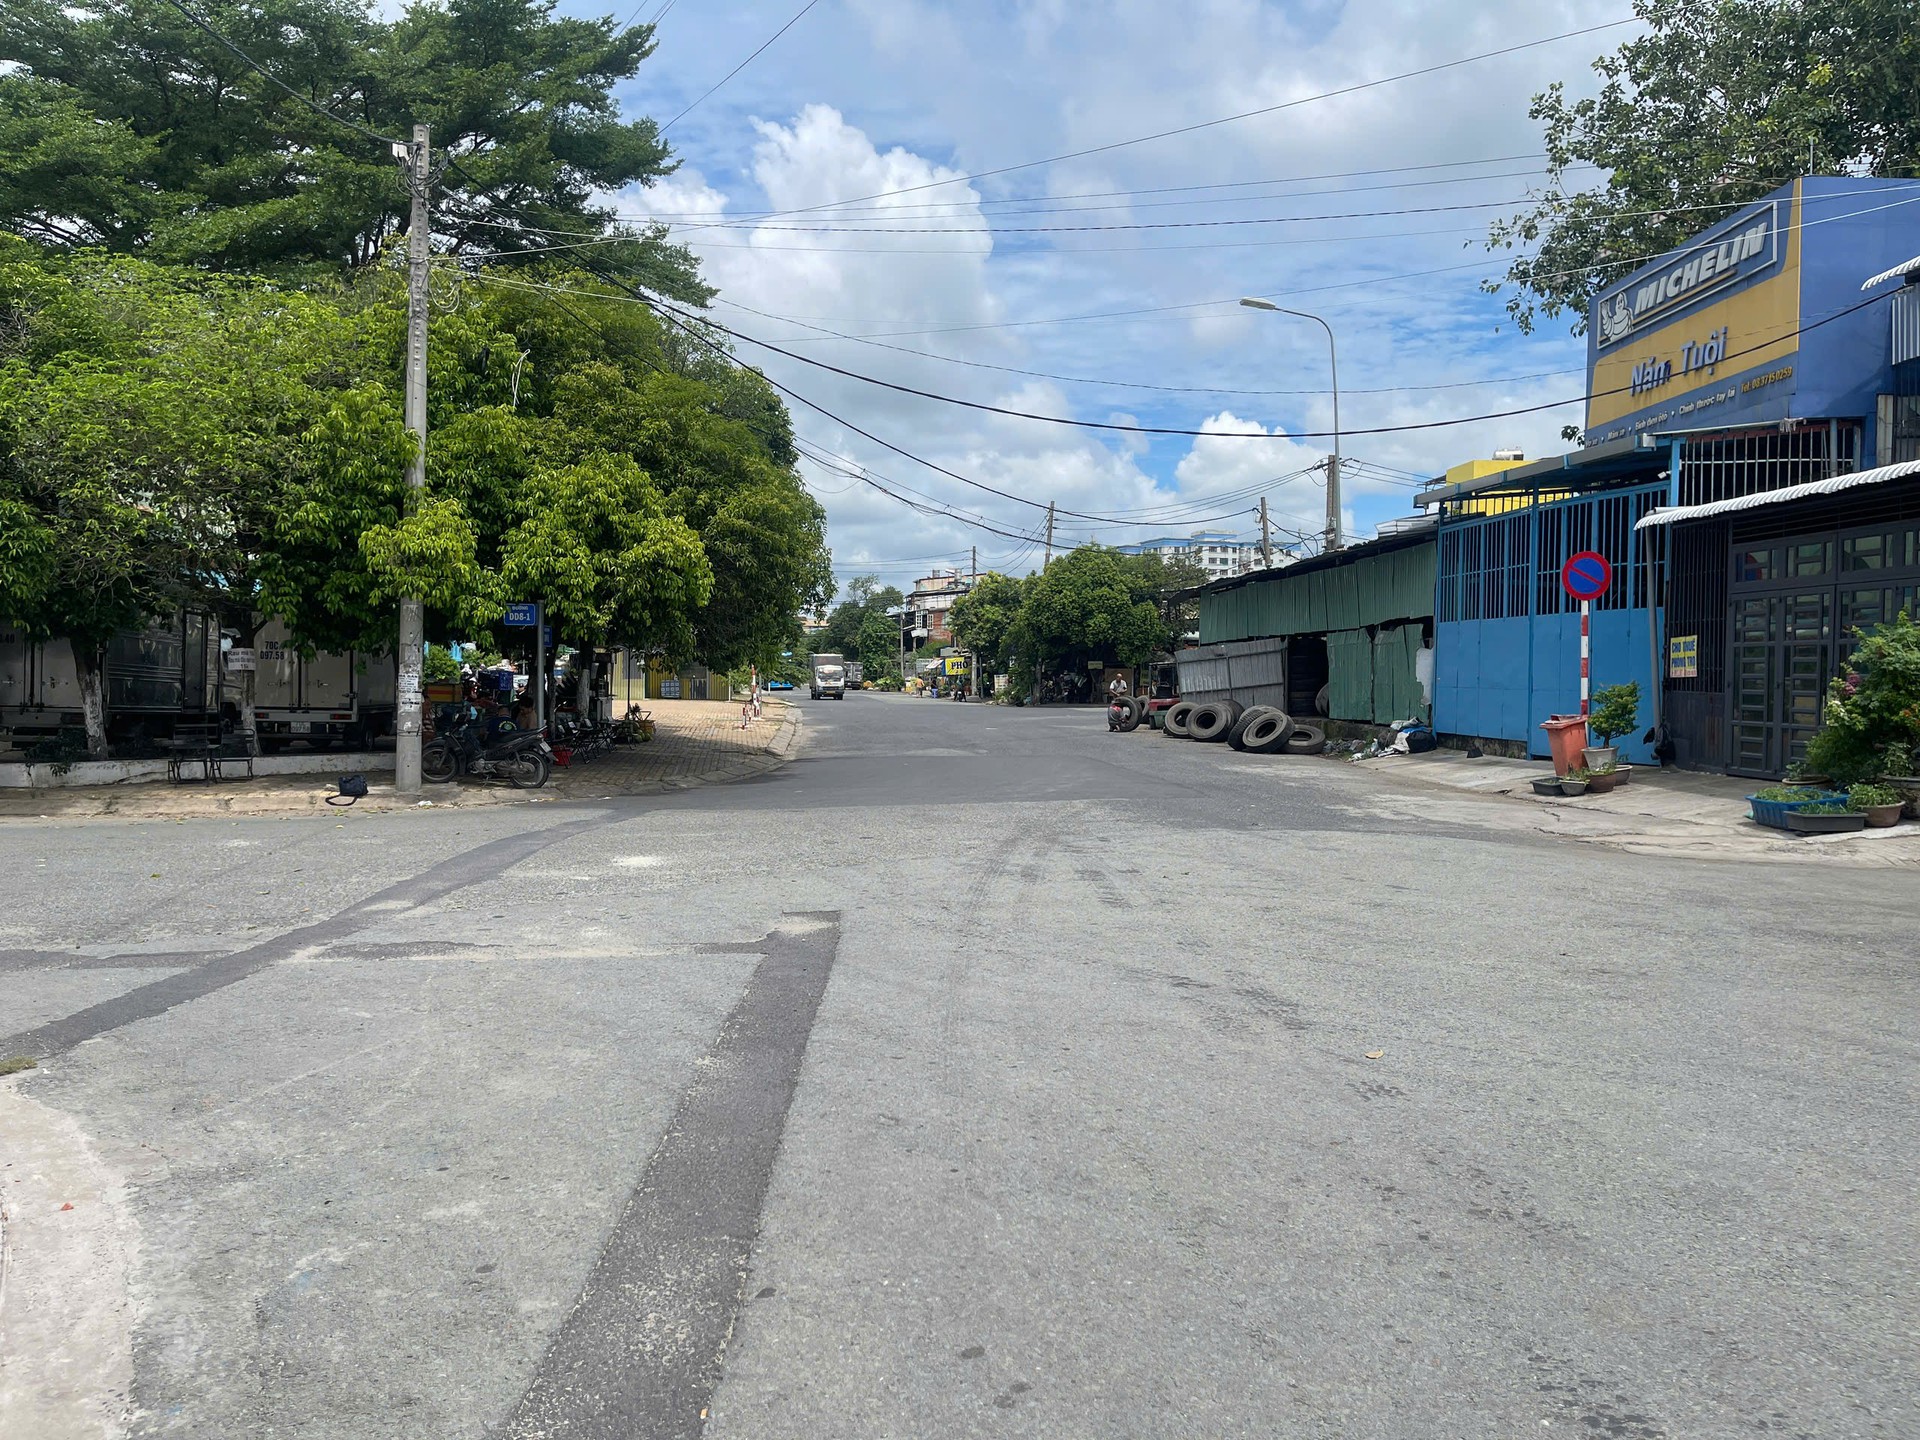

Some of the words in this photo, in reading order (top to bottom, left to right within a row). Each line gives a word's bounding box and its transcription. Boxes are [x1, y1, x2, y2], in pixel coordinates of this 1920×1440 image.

[1634, 222, 1767, 315] MICHELIN
[510, 612, 530, 620] DD8-1
[265, 641, 278, 650] 70C
[260, 651, 284, 660] 097.58
